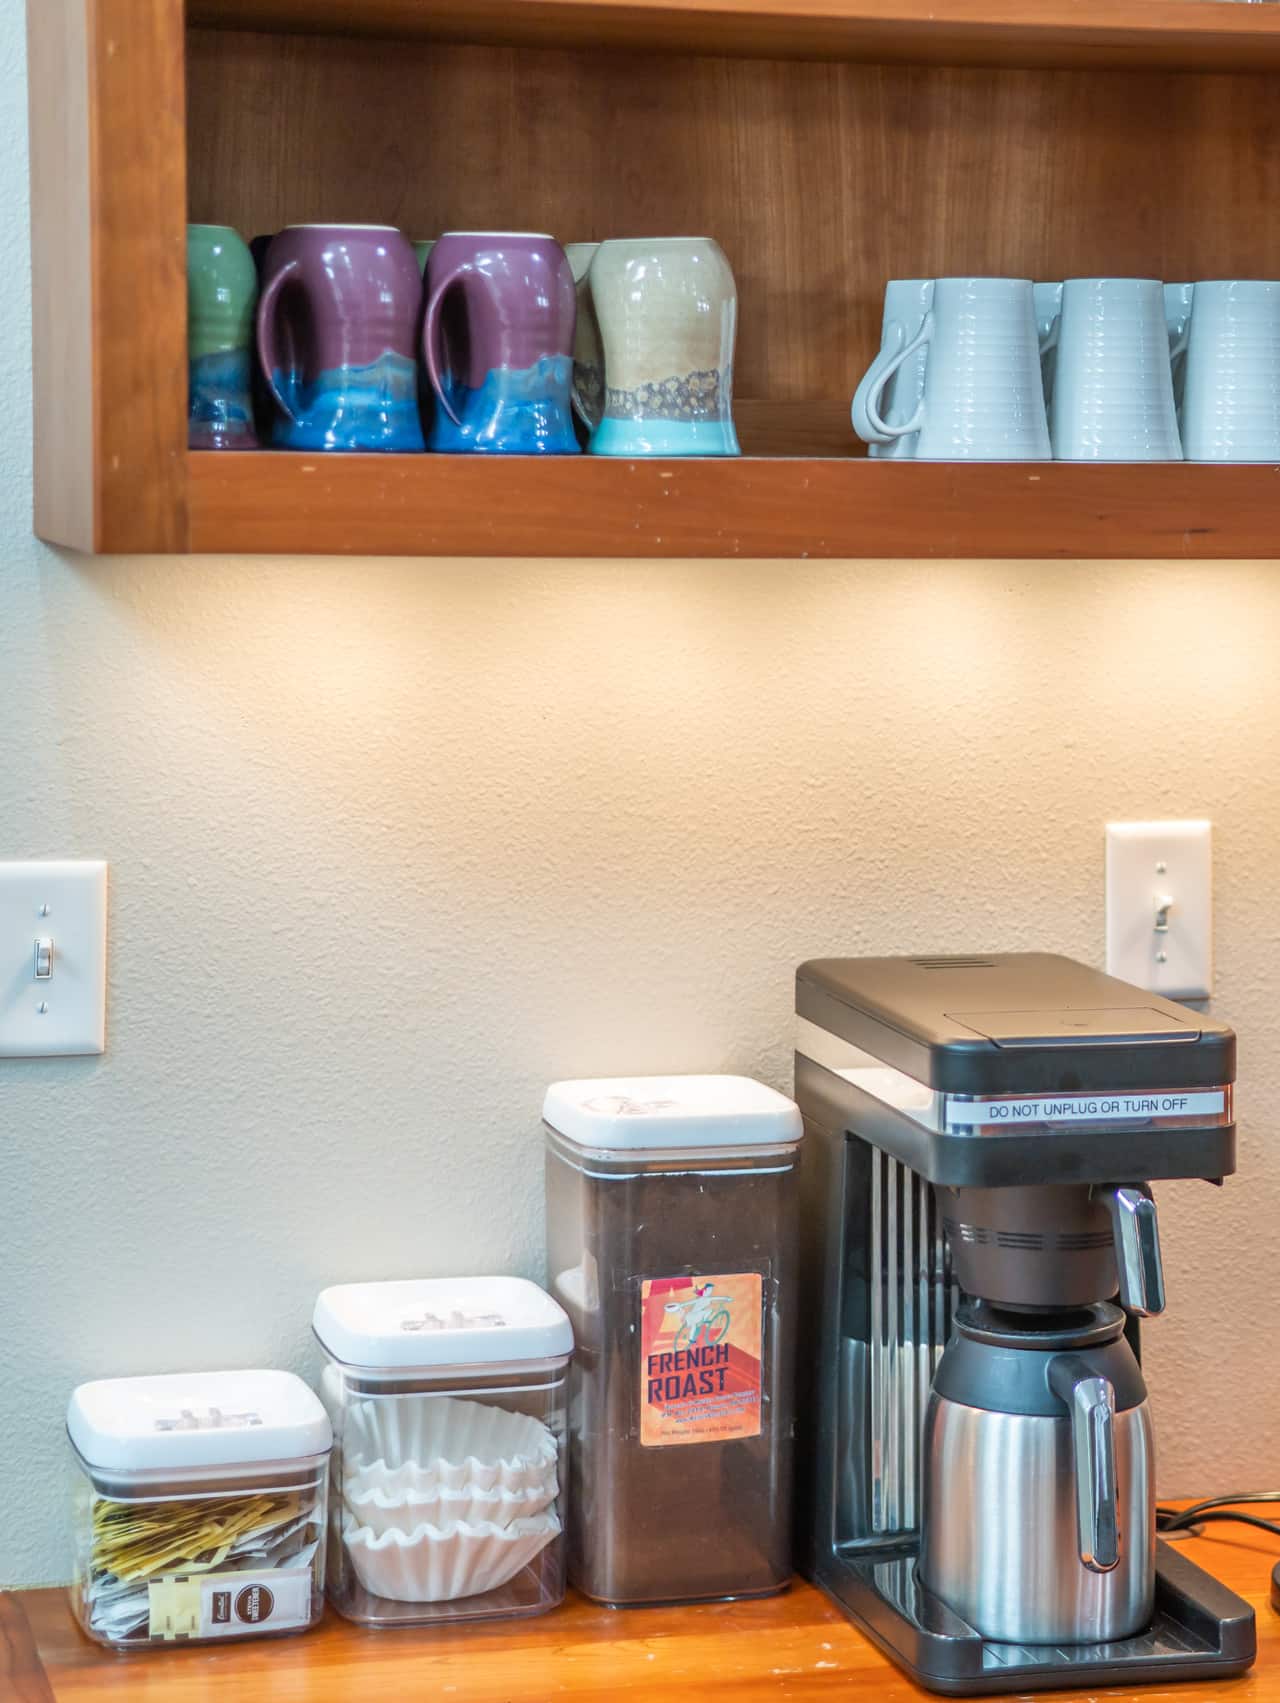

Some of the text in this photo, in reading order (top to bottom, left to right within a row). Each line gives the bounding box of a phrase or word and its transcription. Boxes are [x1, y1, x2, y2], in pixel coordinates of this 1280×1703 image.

[989, 1098, 1188, 1118] DO NOT UNPLUG OR TURN OFF
[648, 1342, 729, 1376] FRENCH
[648, 1367, 729, 1404] ROAST
